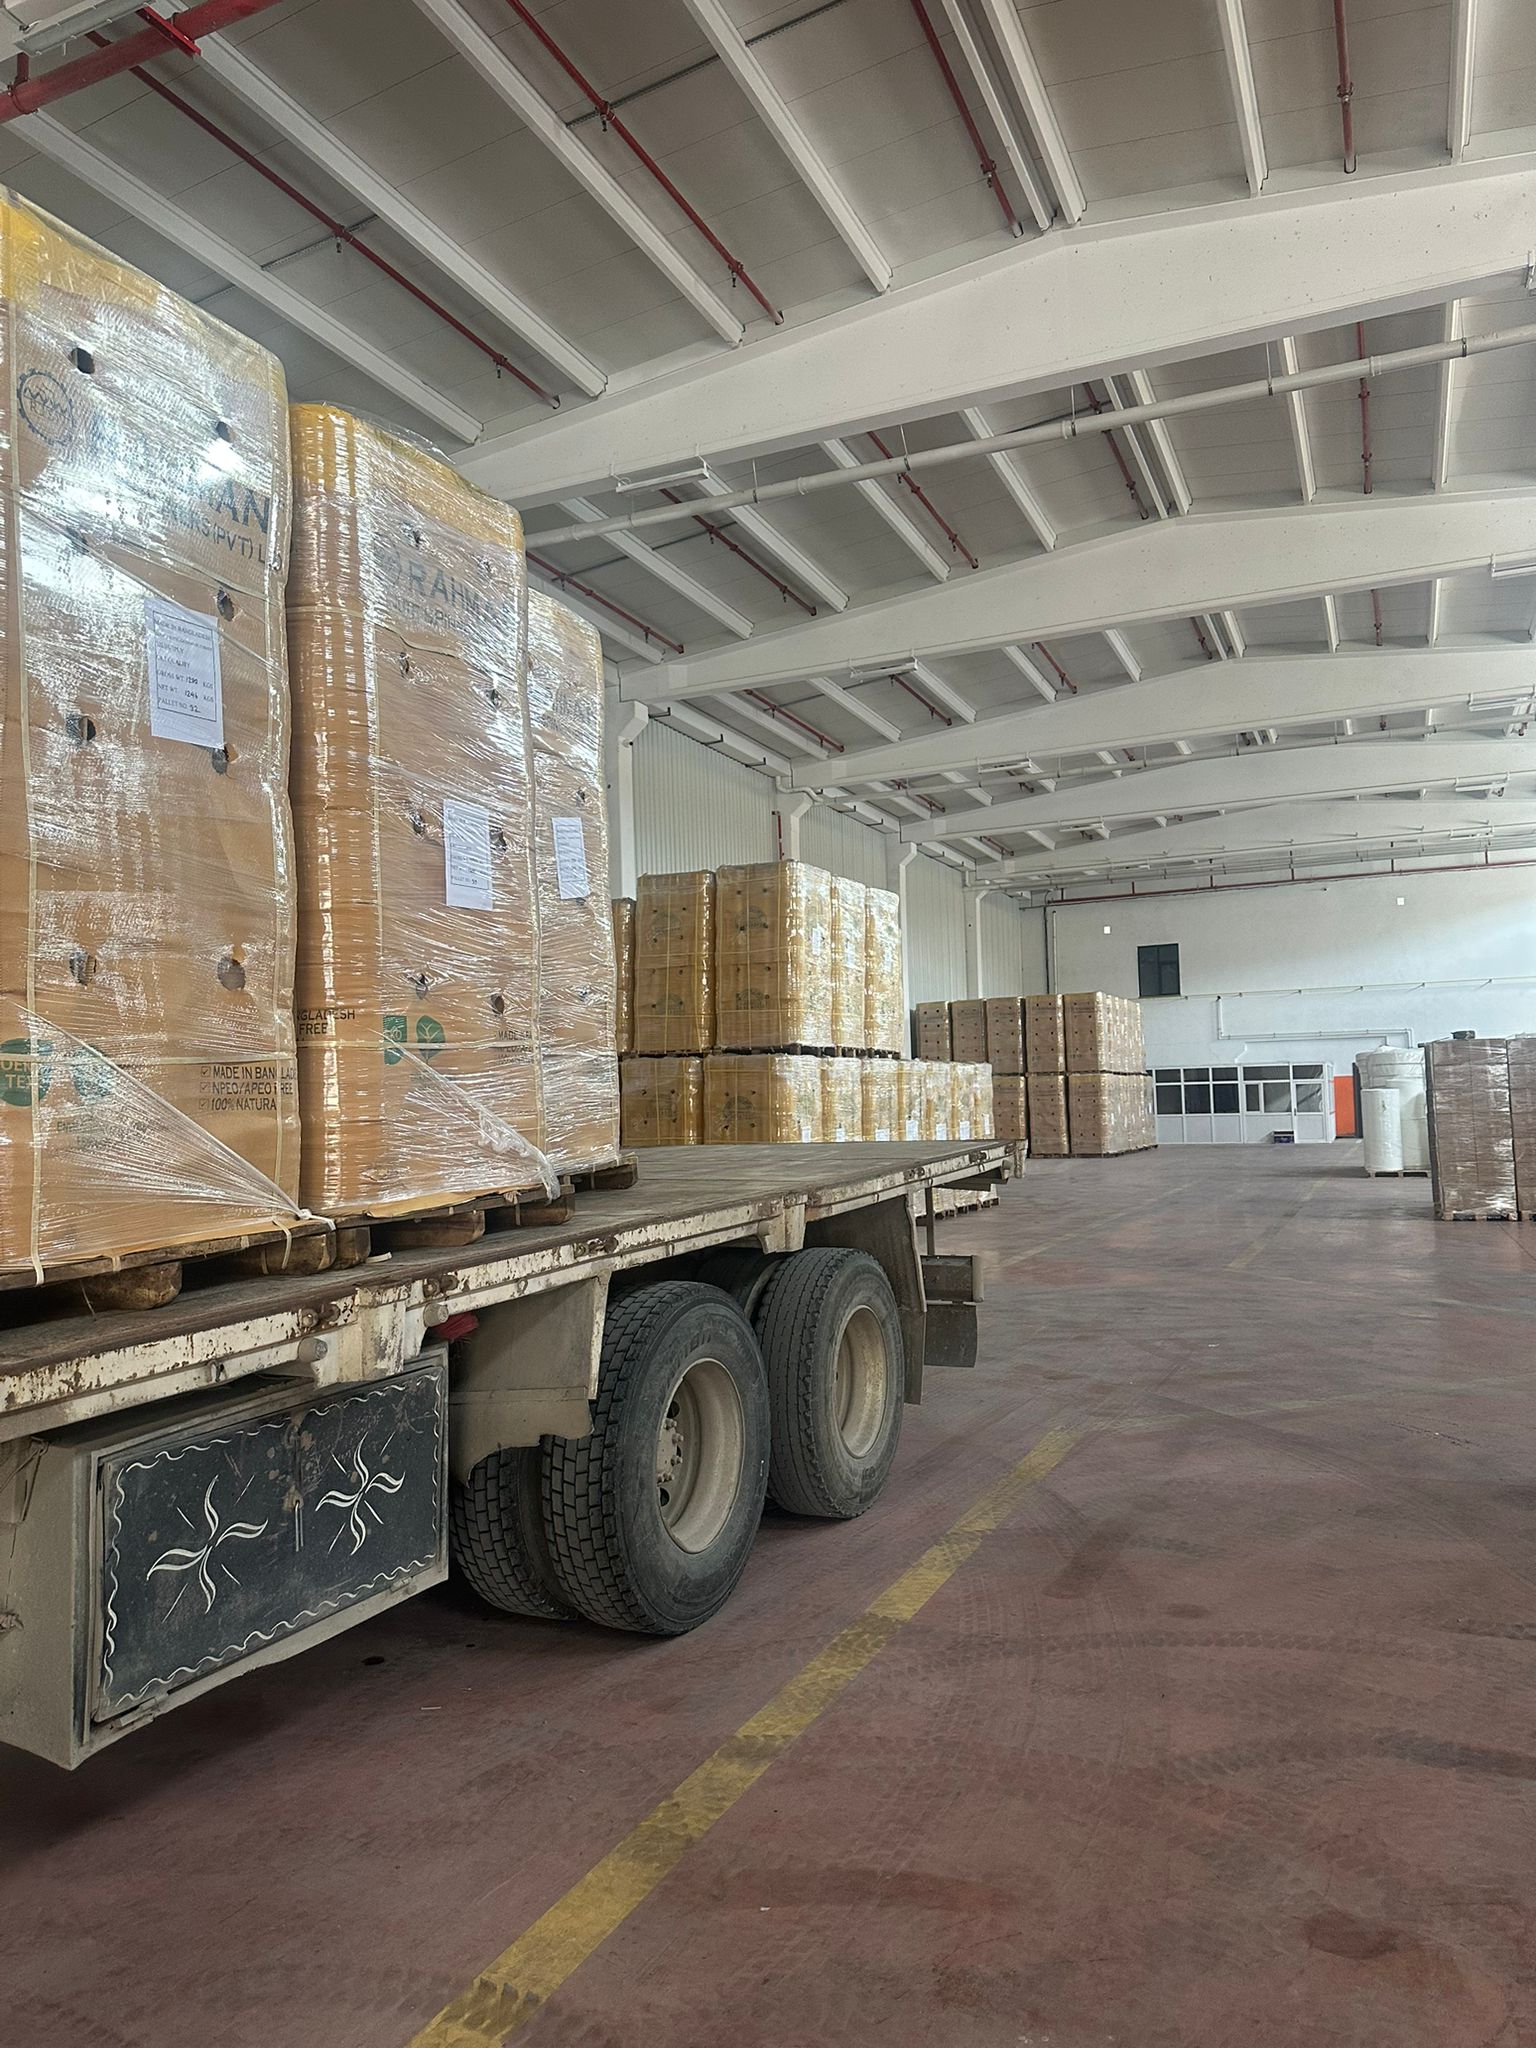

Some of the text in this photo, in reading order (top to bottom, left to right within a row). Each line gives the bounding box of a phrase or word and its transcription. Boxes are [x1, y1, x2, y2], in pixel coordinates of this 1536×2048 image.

[299, 1022, 328, 1035] FREE
[213, 1065, 240, 1079] MADE
[241, 1066, 253, 1079] IN
[213, 1081, 272, 1095] NPEO/APEO
[236, 1097, 277, 1111] NATURA
